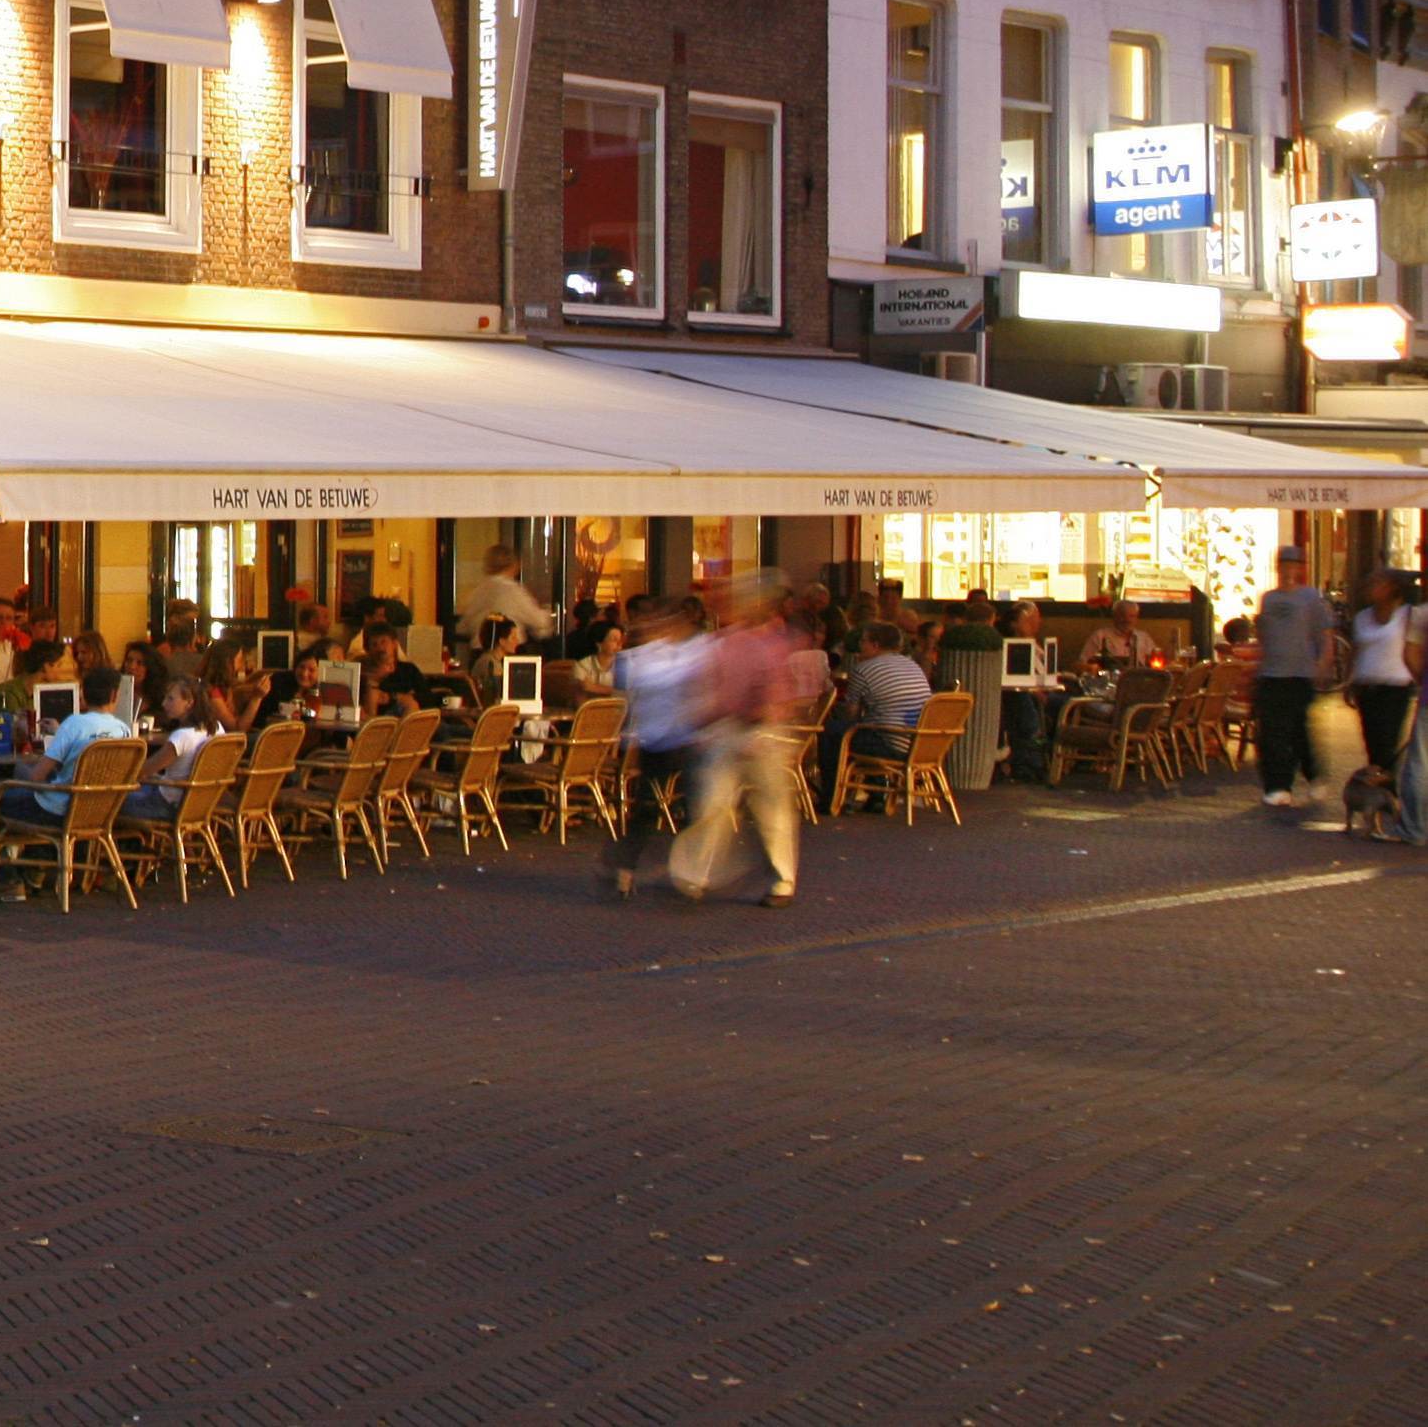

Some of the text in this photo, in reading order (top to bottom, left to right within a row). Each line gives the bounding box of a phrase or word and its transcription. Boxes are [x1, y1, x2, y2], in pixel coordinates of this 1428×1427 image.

[479, 59, 496, 87] DE
[479, 88, 496, 126] VAN
[479, 125, 496, 178] HART
[1105, 163, 1191, 190] KLM
[1114, 199, 1182, 227] agent
[879, 300, 970, 312] INTERNATIONAL
[897, 317, 951, 327] VAKANTIES
[213, 487, 370, 509] HART VAN DE BETUWE
[824, 489, 933, 507] HART VAN DE BETUWE
[1267, 486, 1287, 502] HART
[1289, 486, 1307, 502] VAN
[1308, 486, 1319, 502] DE
